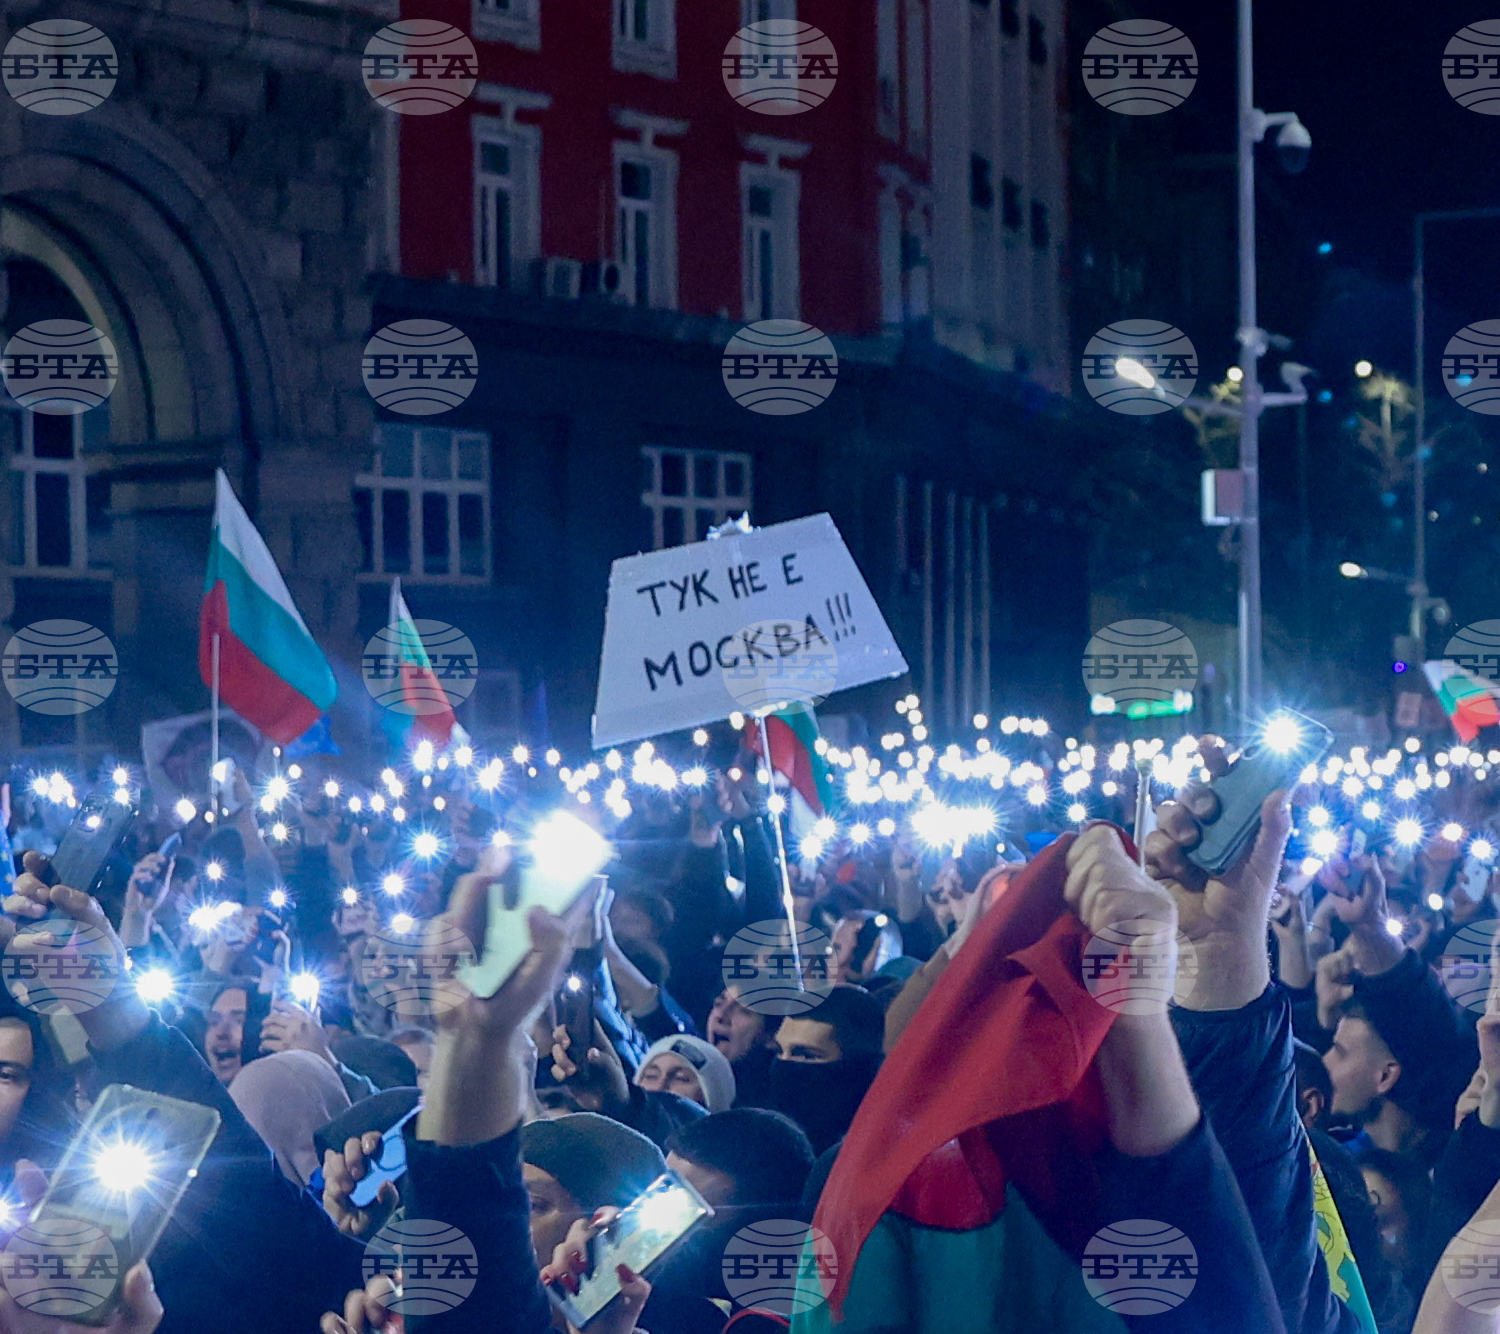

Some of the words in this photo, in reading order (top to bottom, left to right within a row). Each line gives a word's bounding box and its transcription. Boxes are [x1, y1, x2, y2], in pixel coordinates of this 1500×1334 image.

[636, 569, 719, 617] ТУК
[728, 561, 768, 599] НЕ
[782, 553, 804, 585] Е
[643, 592, 857, 692] МОСКВА!!!
